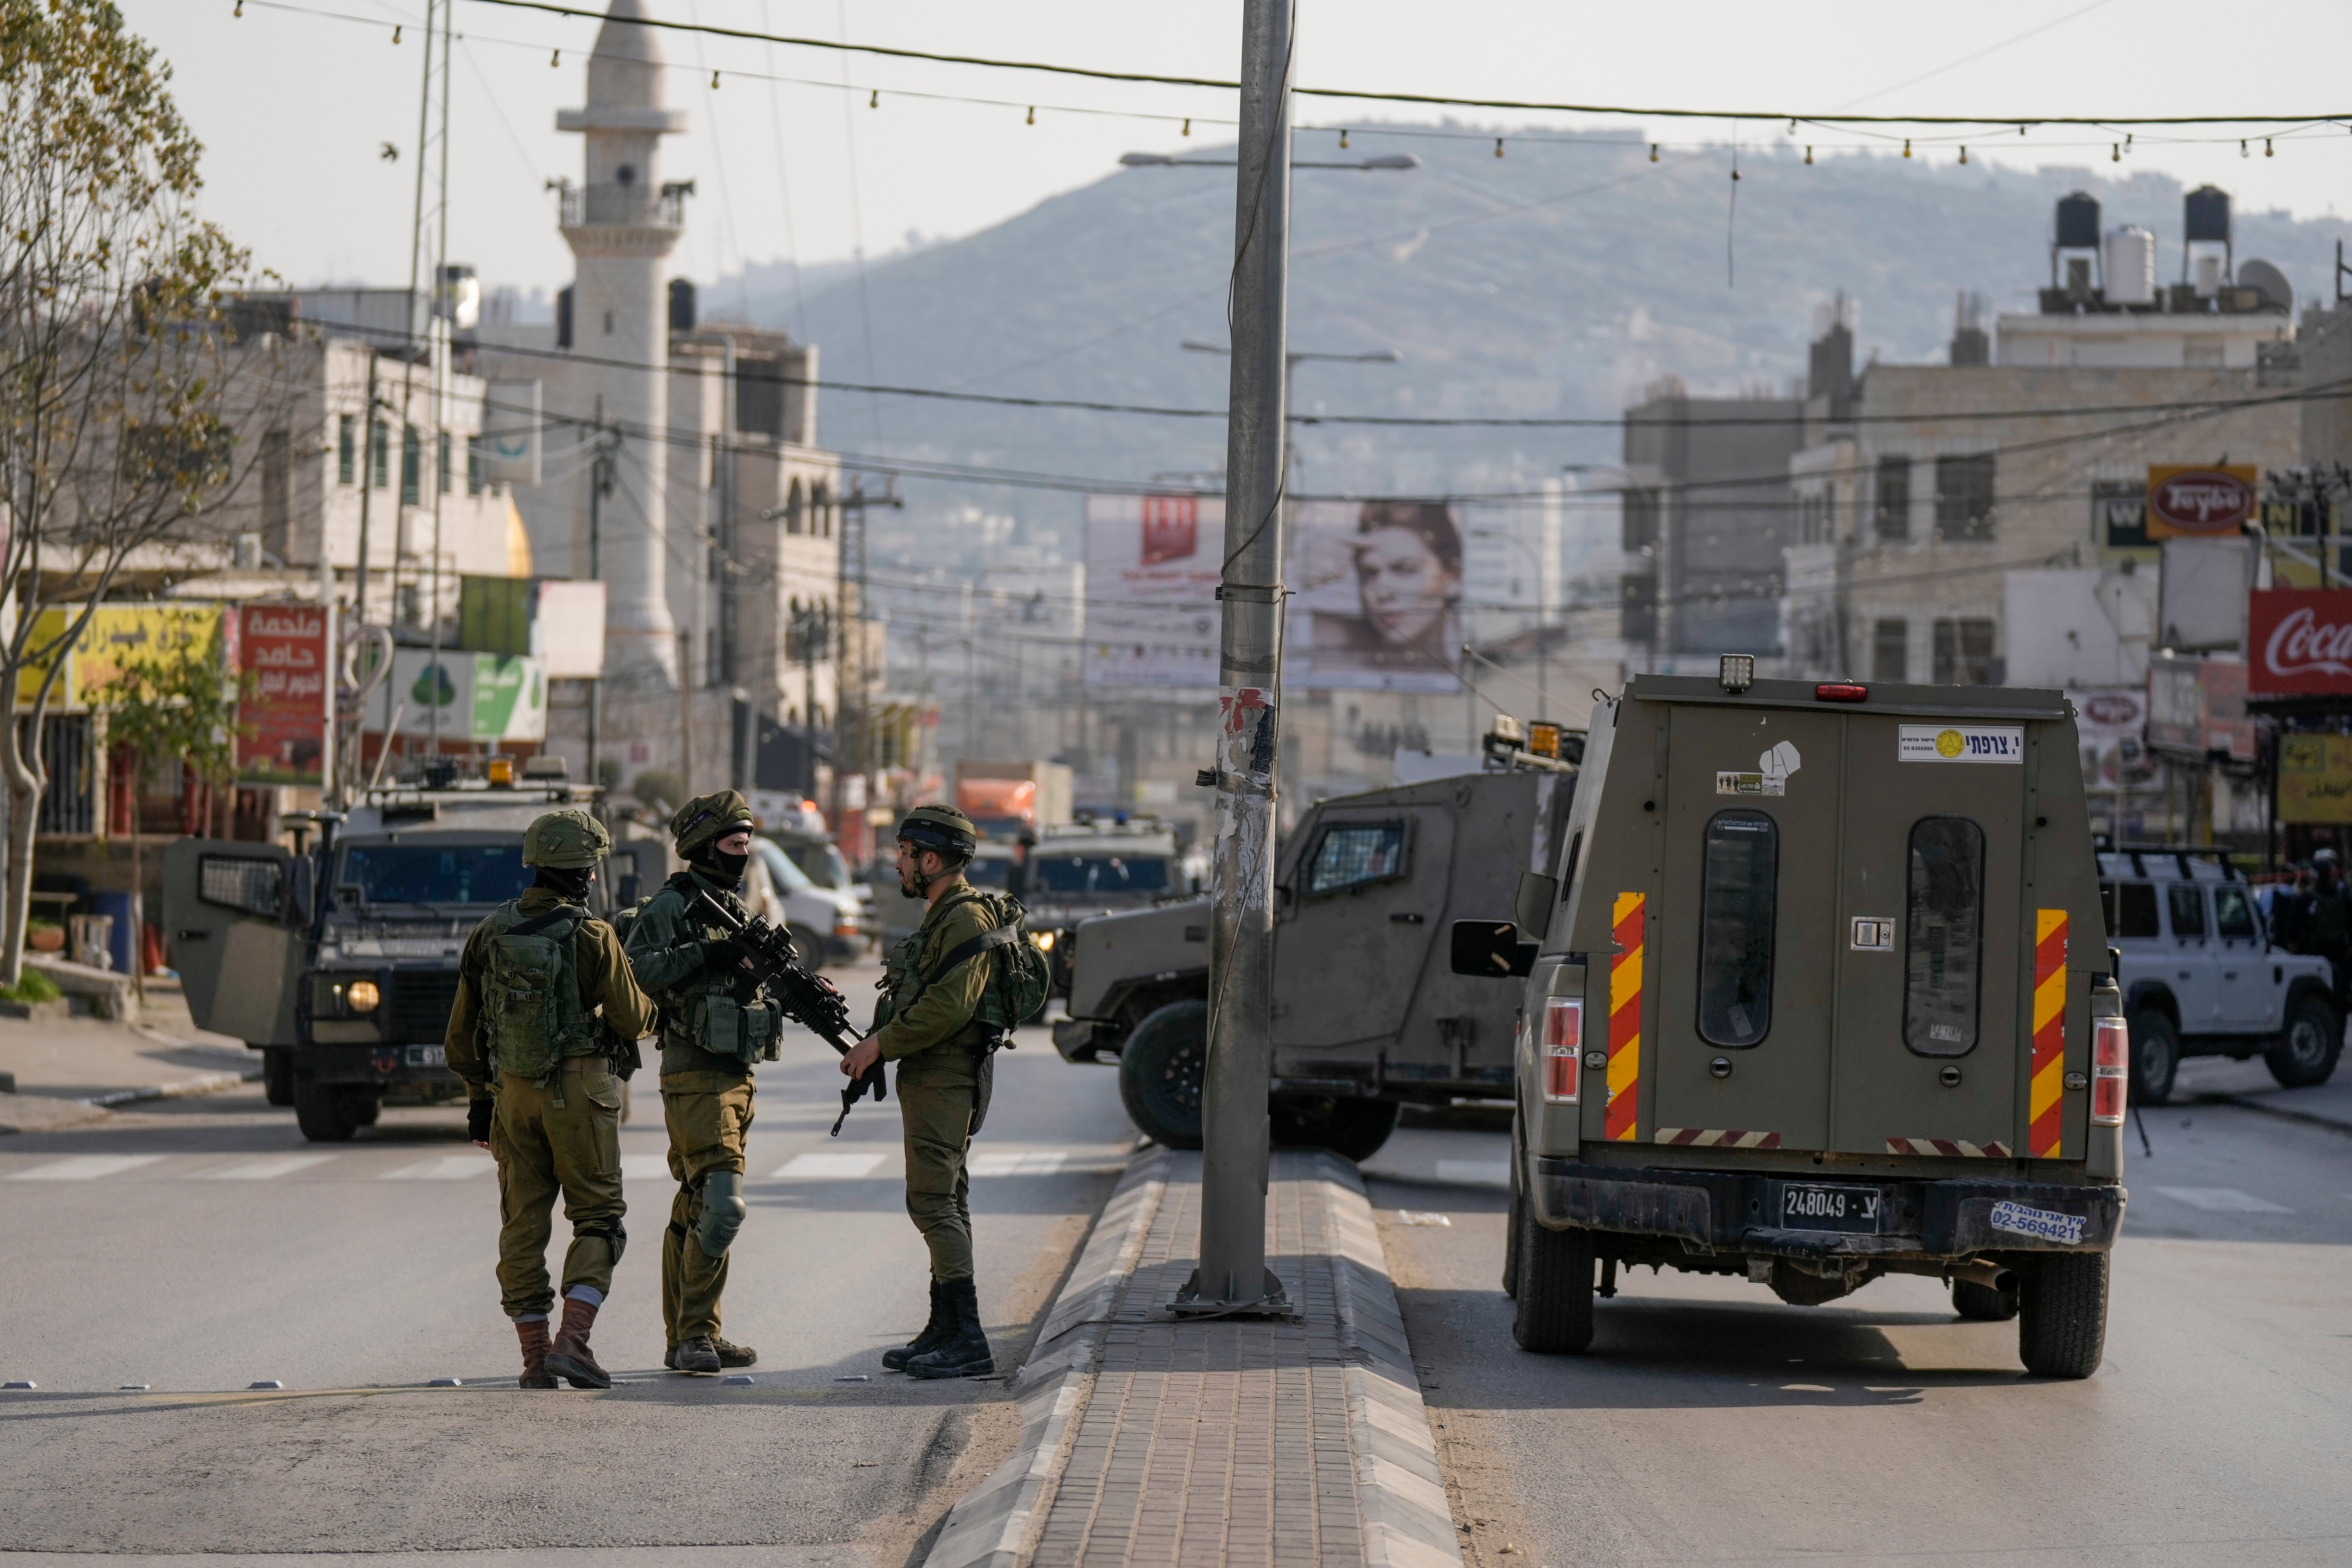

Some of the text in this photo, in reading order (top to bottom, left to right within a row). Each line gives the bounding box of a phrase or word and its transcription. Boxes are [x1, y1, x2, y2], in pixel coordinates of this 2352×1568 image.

[248, 610, 322, 639] ملحمة
[256, 642, 315, 667] حامد
[1965, 735, 2008, 755] צרפתי
[1786, 1190, 1846, 1217] 248049
[2045, 1212, 2064, 1222] אני
[2067, 1216, 2085, 1226] איך
